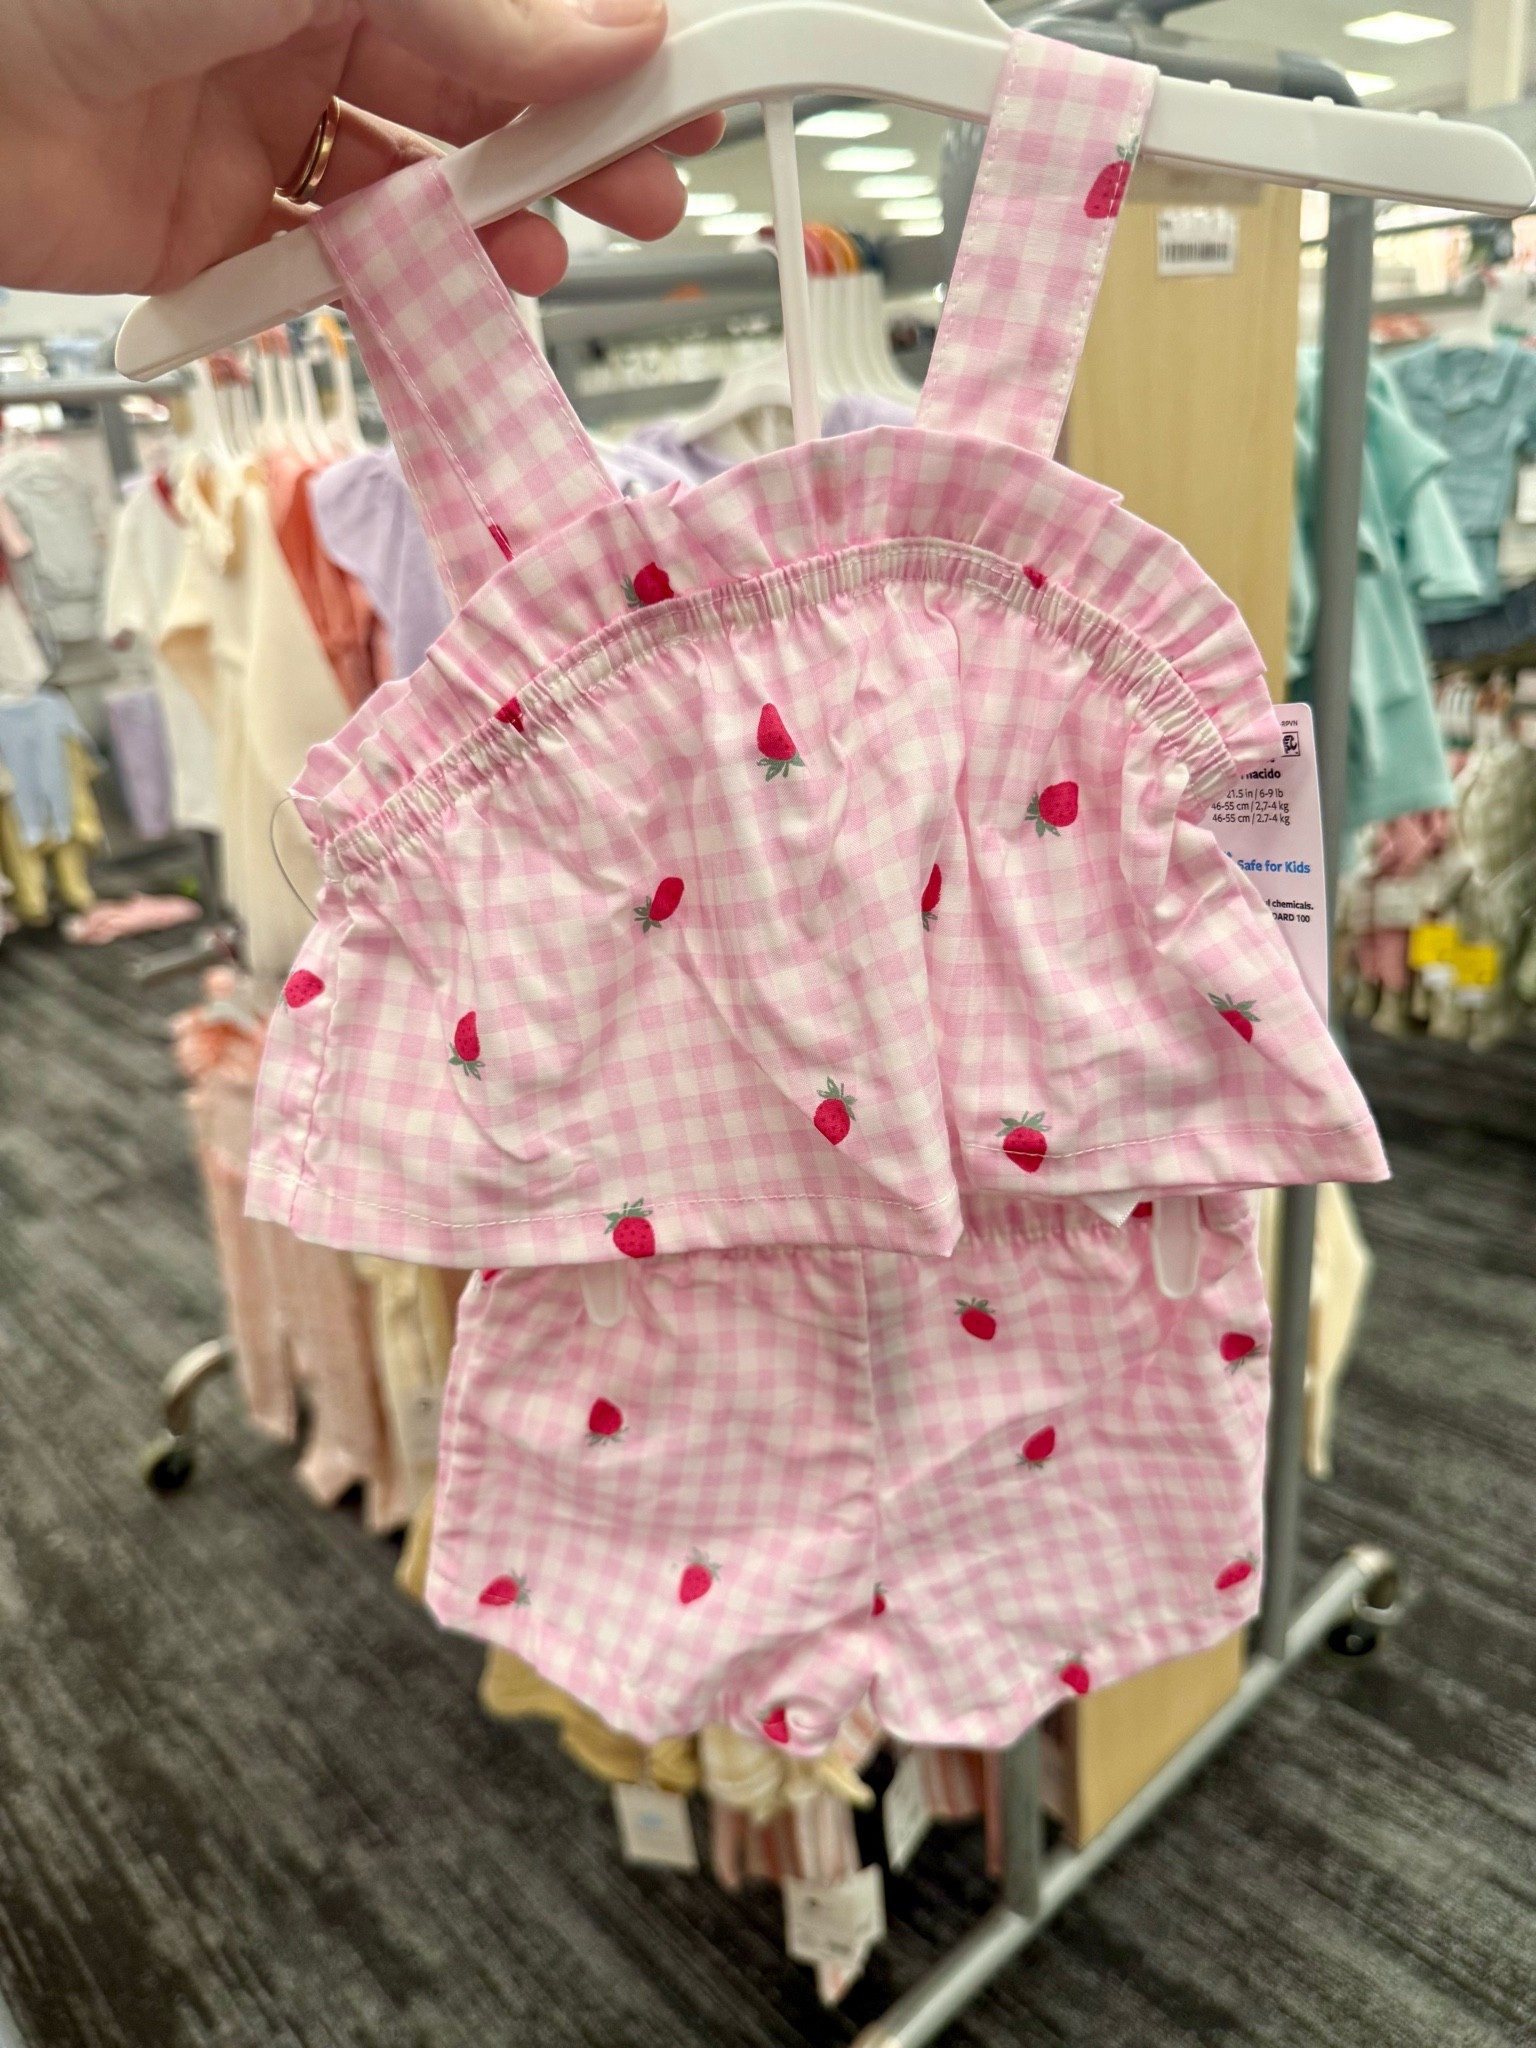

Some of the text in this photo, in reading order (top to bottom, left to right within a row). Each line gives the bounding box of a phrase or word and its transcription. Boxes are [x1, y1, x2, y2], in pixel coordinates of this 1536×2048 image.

[1226, 789, 1243, 798] 21.5
[1245, 788, 1253, 798] in
[1259, 788, 1274, 798] 6-9
[1275, 788, 1284, 798] lb
[1211, 801, 1235, 811] 46-55
[1236, 803, 1249, 811] cm
[1255, 801, 1277, 812] 2,7-4
[1278, 801, 1289, 813] kg
[1212, 813, 1236, 823] 46-55
[1237, 815, 1250, 823] cm
[1257, 813, 1278, 823] 2.7-4
[1280, 813, 1290, 826] kg
[1237, 859, 1311, 873] Safe for Kids
[1272, 899, 1314, 910] chemicals.
[1296, 914, 1310, 923] 100
